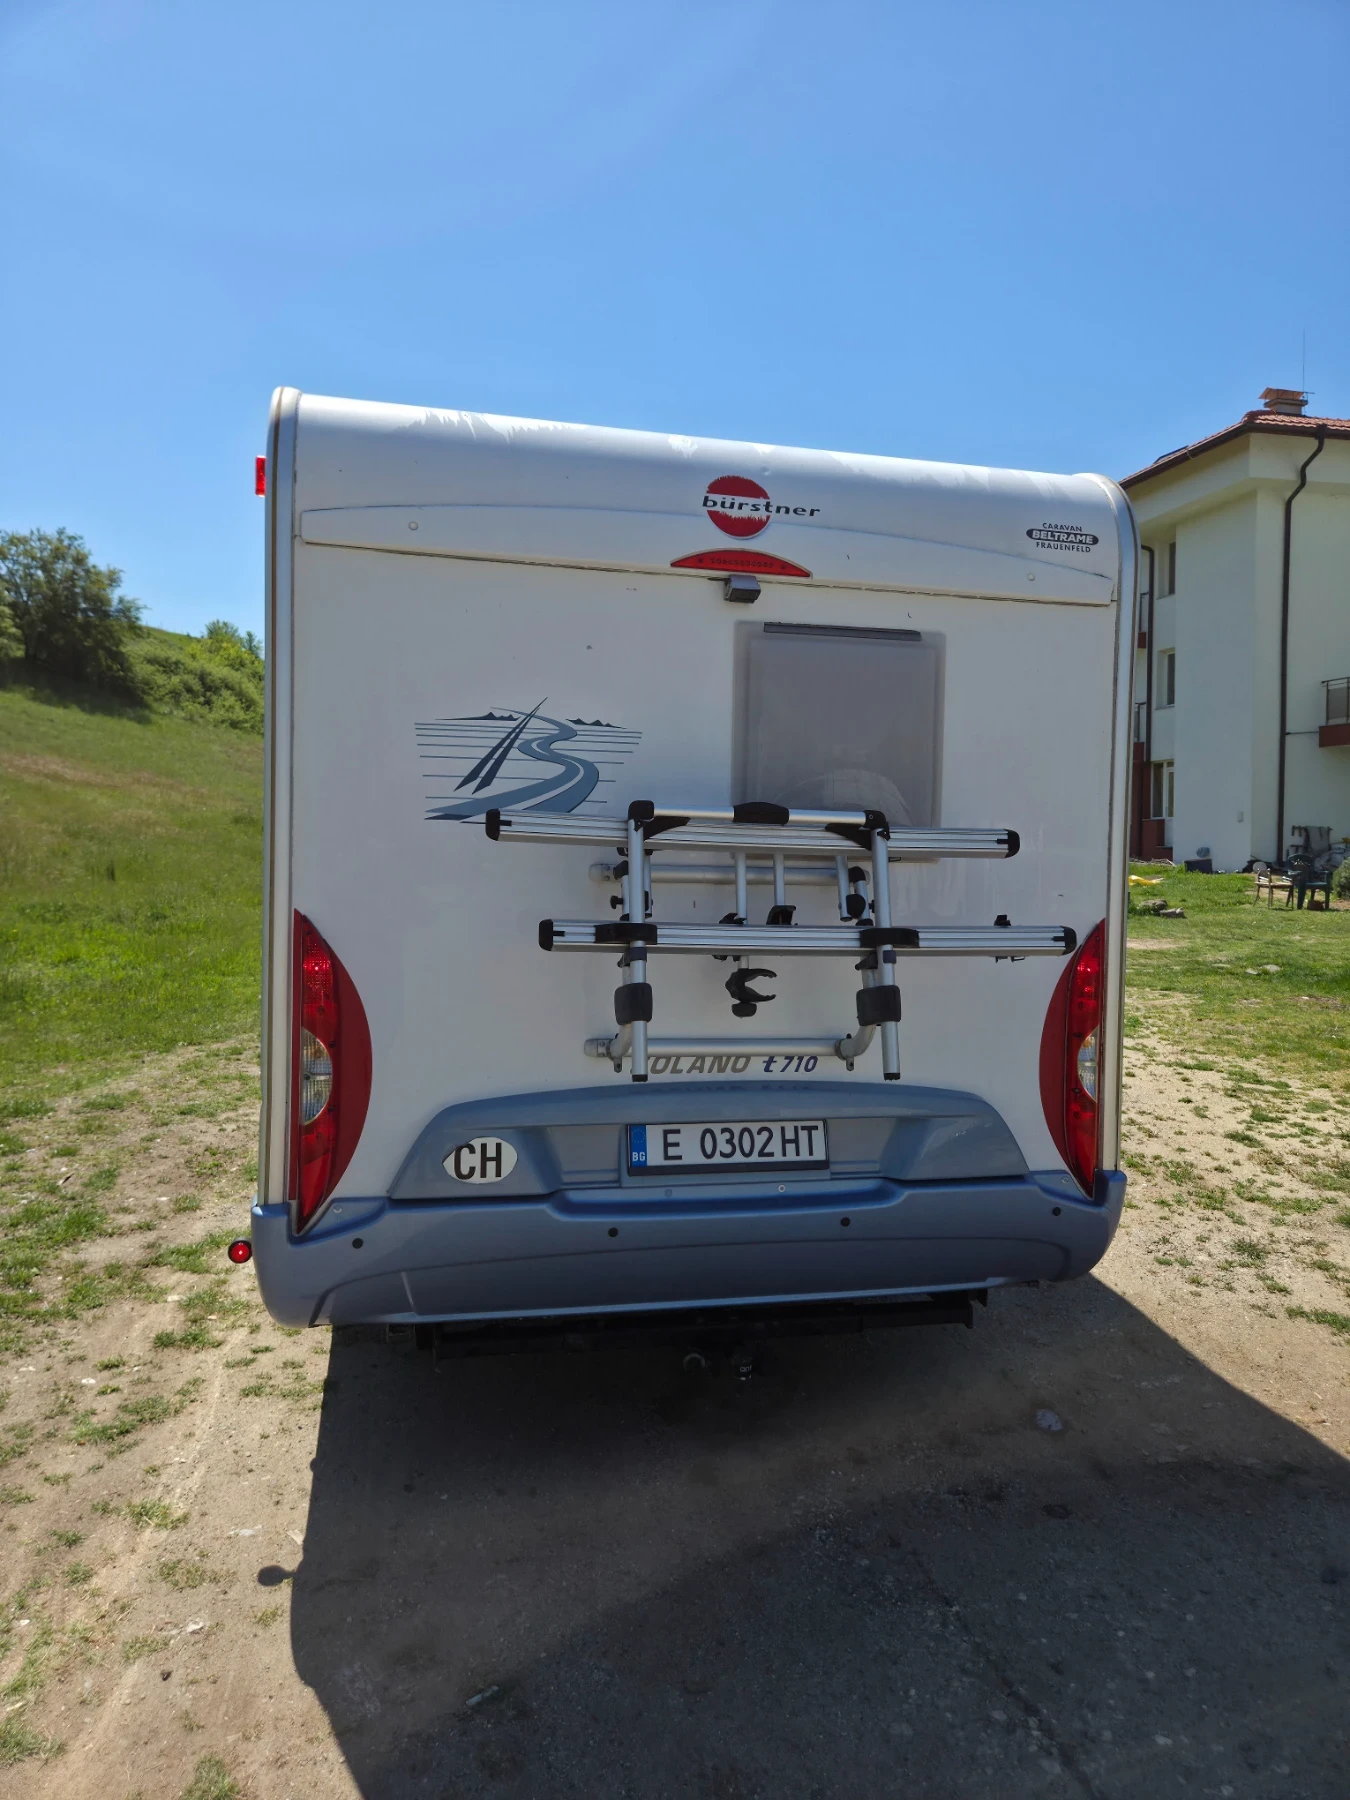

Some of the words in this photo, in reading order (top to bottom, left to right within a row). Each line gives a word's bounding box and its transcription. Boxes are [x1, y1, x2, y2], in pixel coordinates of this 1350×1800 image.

[702, 496, 821, 517] bürstner
[1042, 522, 1082, 533] CARAVAN
[1031, 530, 1094, 545] BELTRAME
[1036, 541, 1091, 553] FRAUENFELD
[630, 1056, 751, 1075] OLANO
[762, 1055, 818, 1073] t710
[662, 1129, 683, 1161] E
[454, 1142, 502, 1180] CH
[632, 1152, 646, 1162] BG
